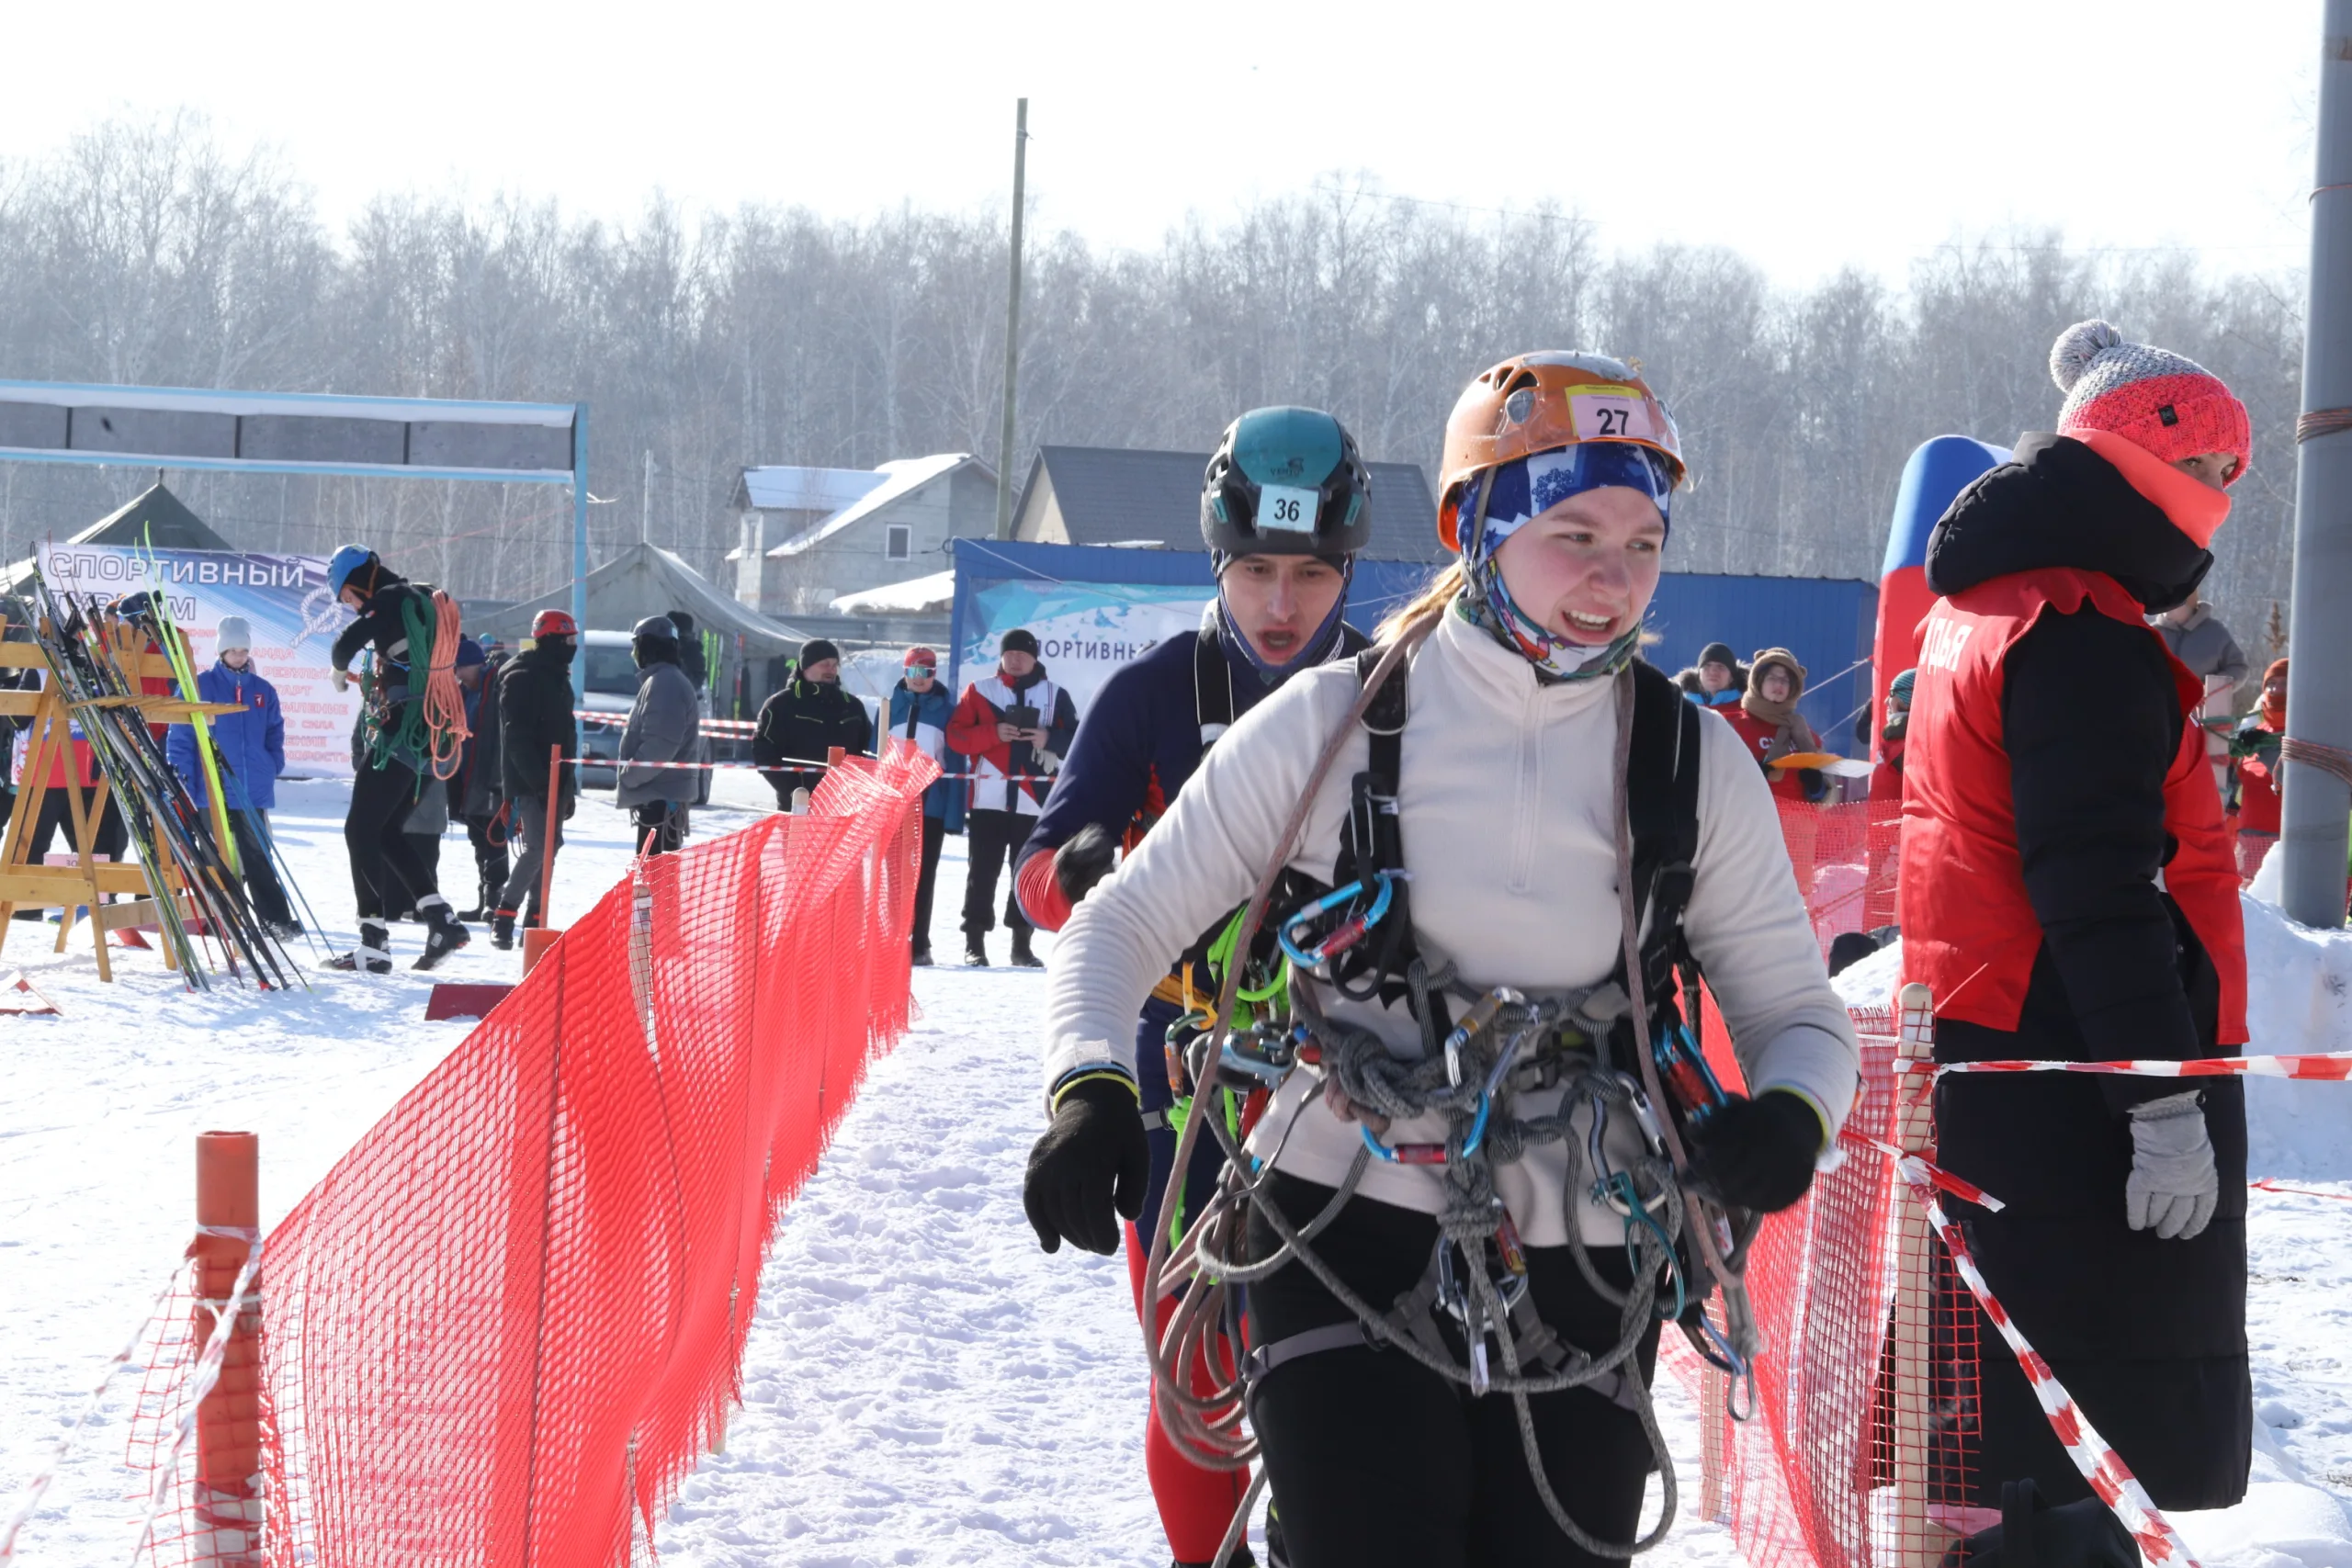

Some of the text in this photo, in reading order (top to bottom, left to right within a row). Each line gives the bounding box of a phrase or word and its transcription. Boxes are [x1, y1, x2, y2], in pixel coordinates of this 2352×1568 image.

[1596, 408, 1630, 436] 27
[1273, 499, 1301, 522] 36
[48, 552, 305, 588] СПОРТИВНЫЙ
